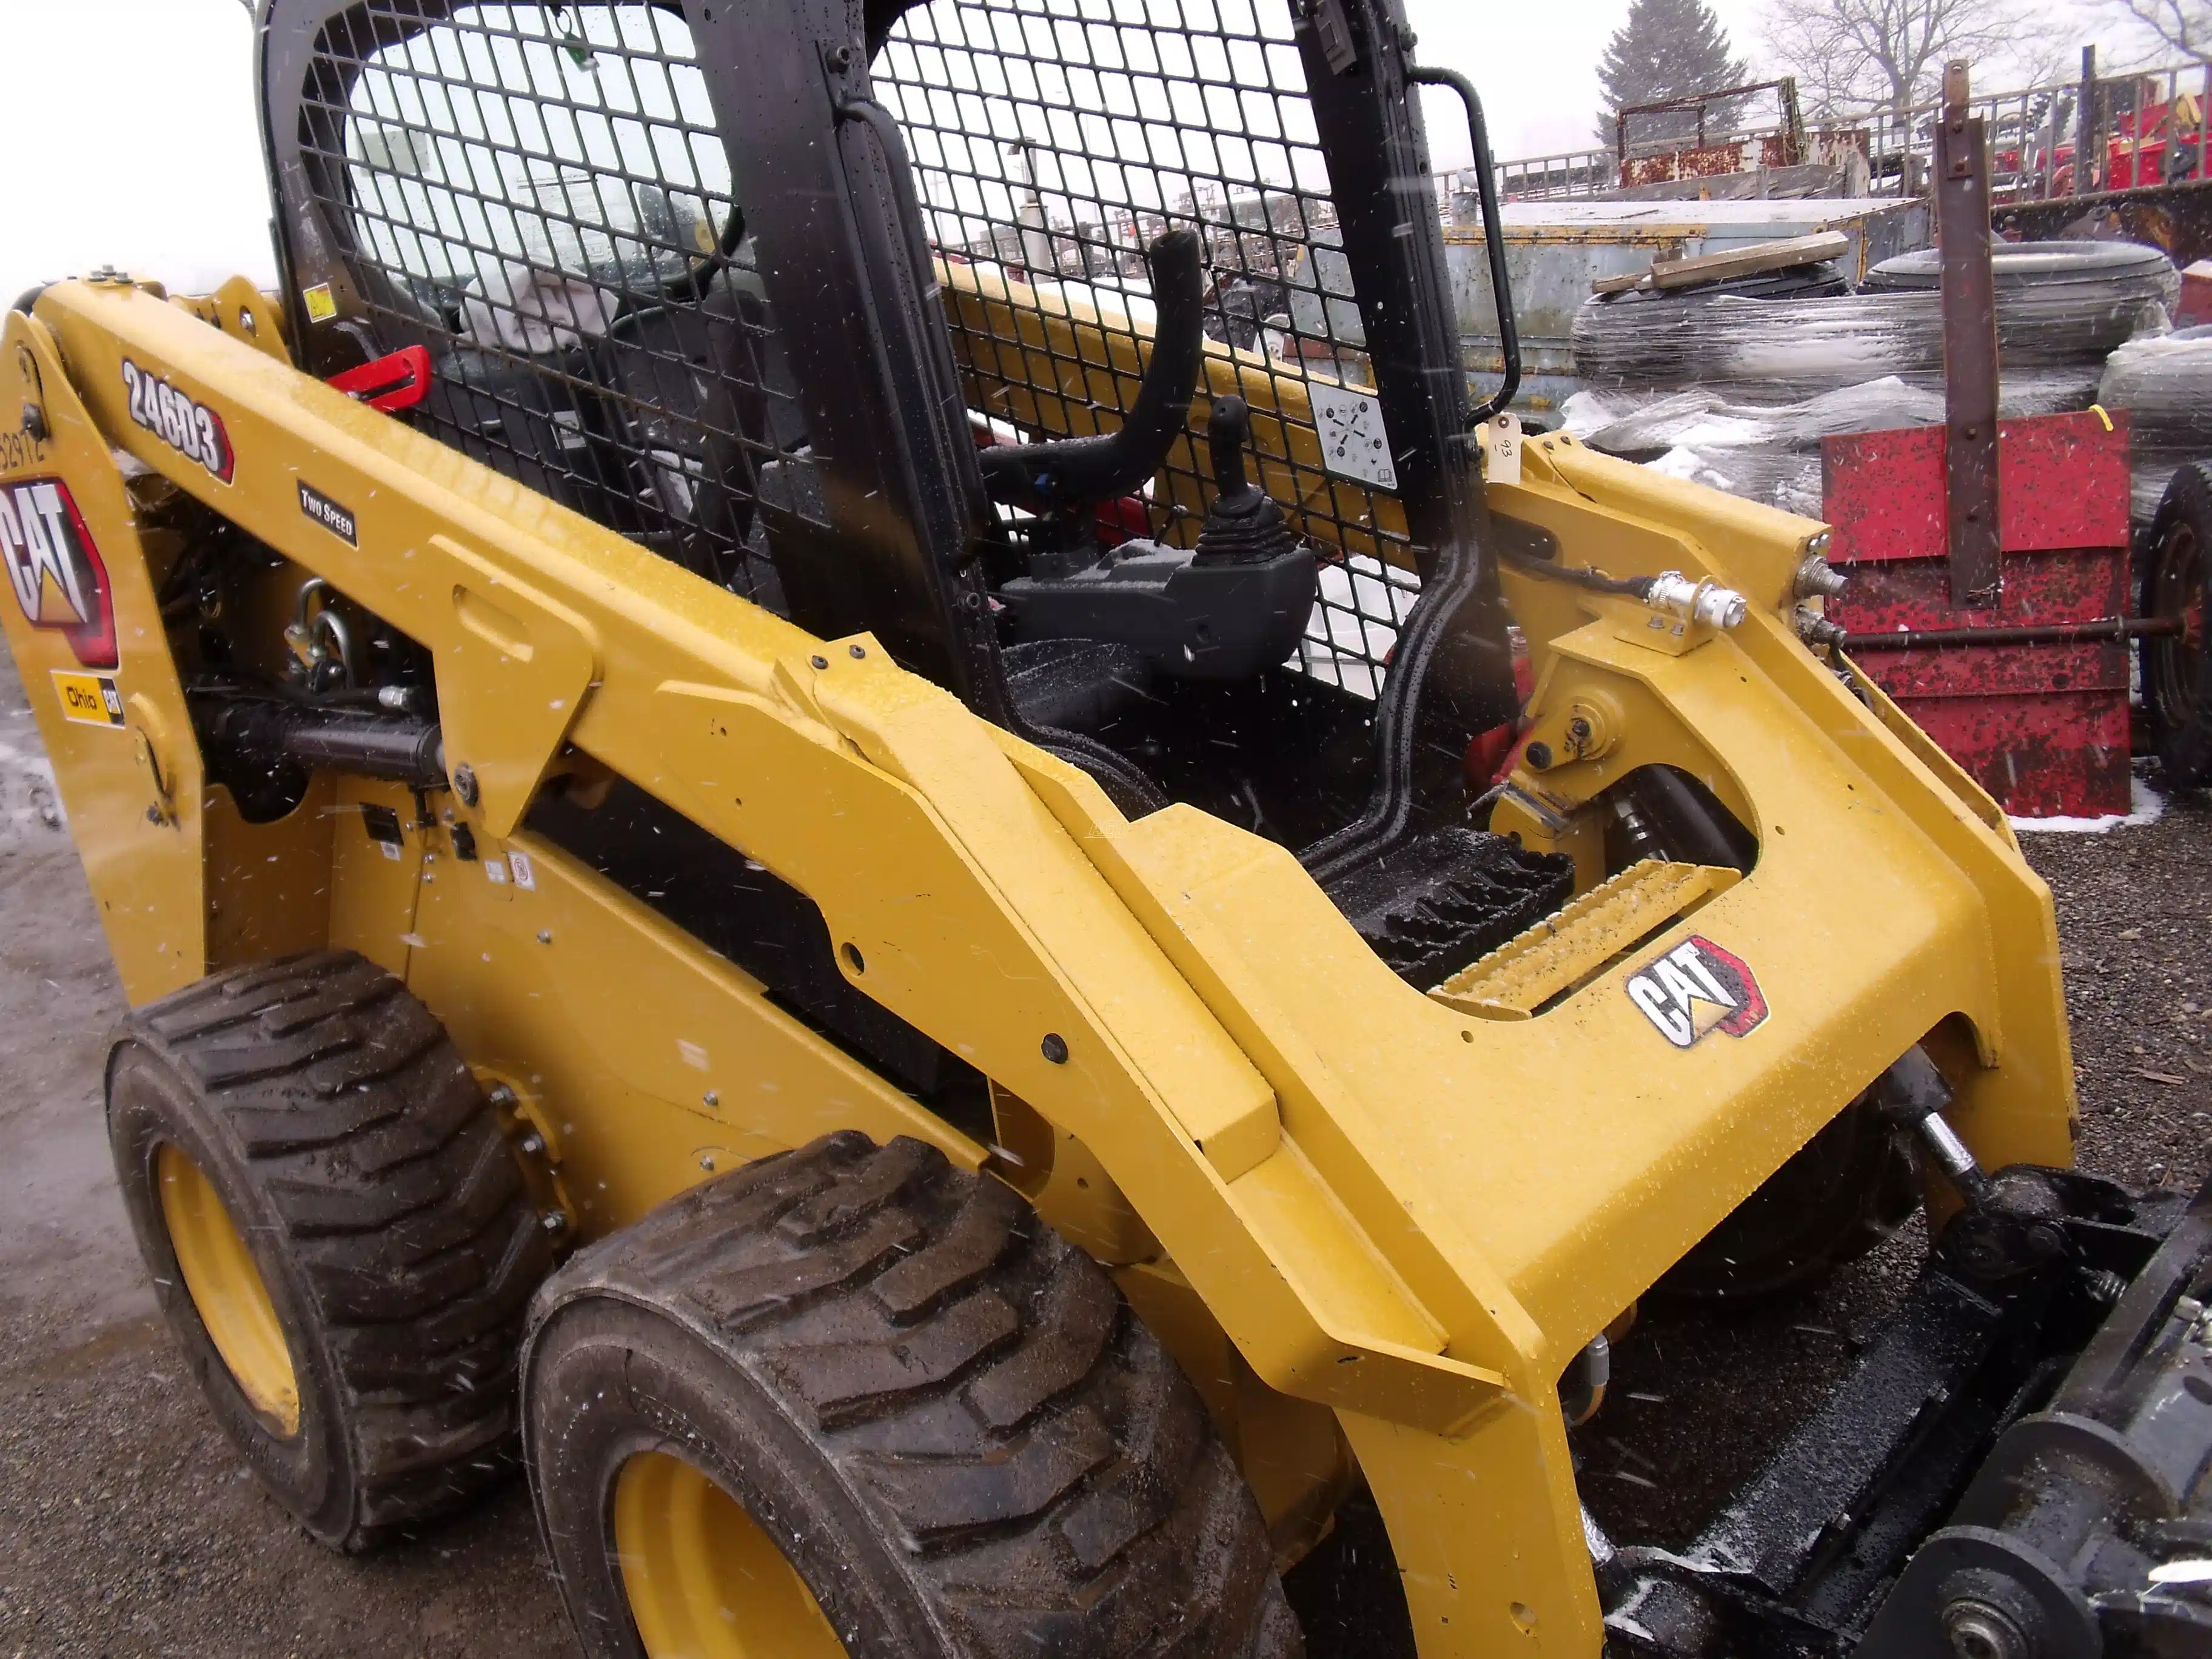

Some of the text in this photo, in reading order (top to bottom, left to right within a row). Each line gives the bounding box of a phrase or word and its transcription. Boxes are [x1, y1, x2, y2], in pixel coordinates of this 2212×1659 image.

[122, 361, 219, 471] 246D3
[1501, 440, 1513, 457] 93
[0, 484, 88, 622] CAT
[65, 686, 98, 711] Ohio
[1628, 941, 1739, 1046] CAT
